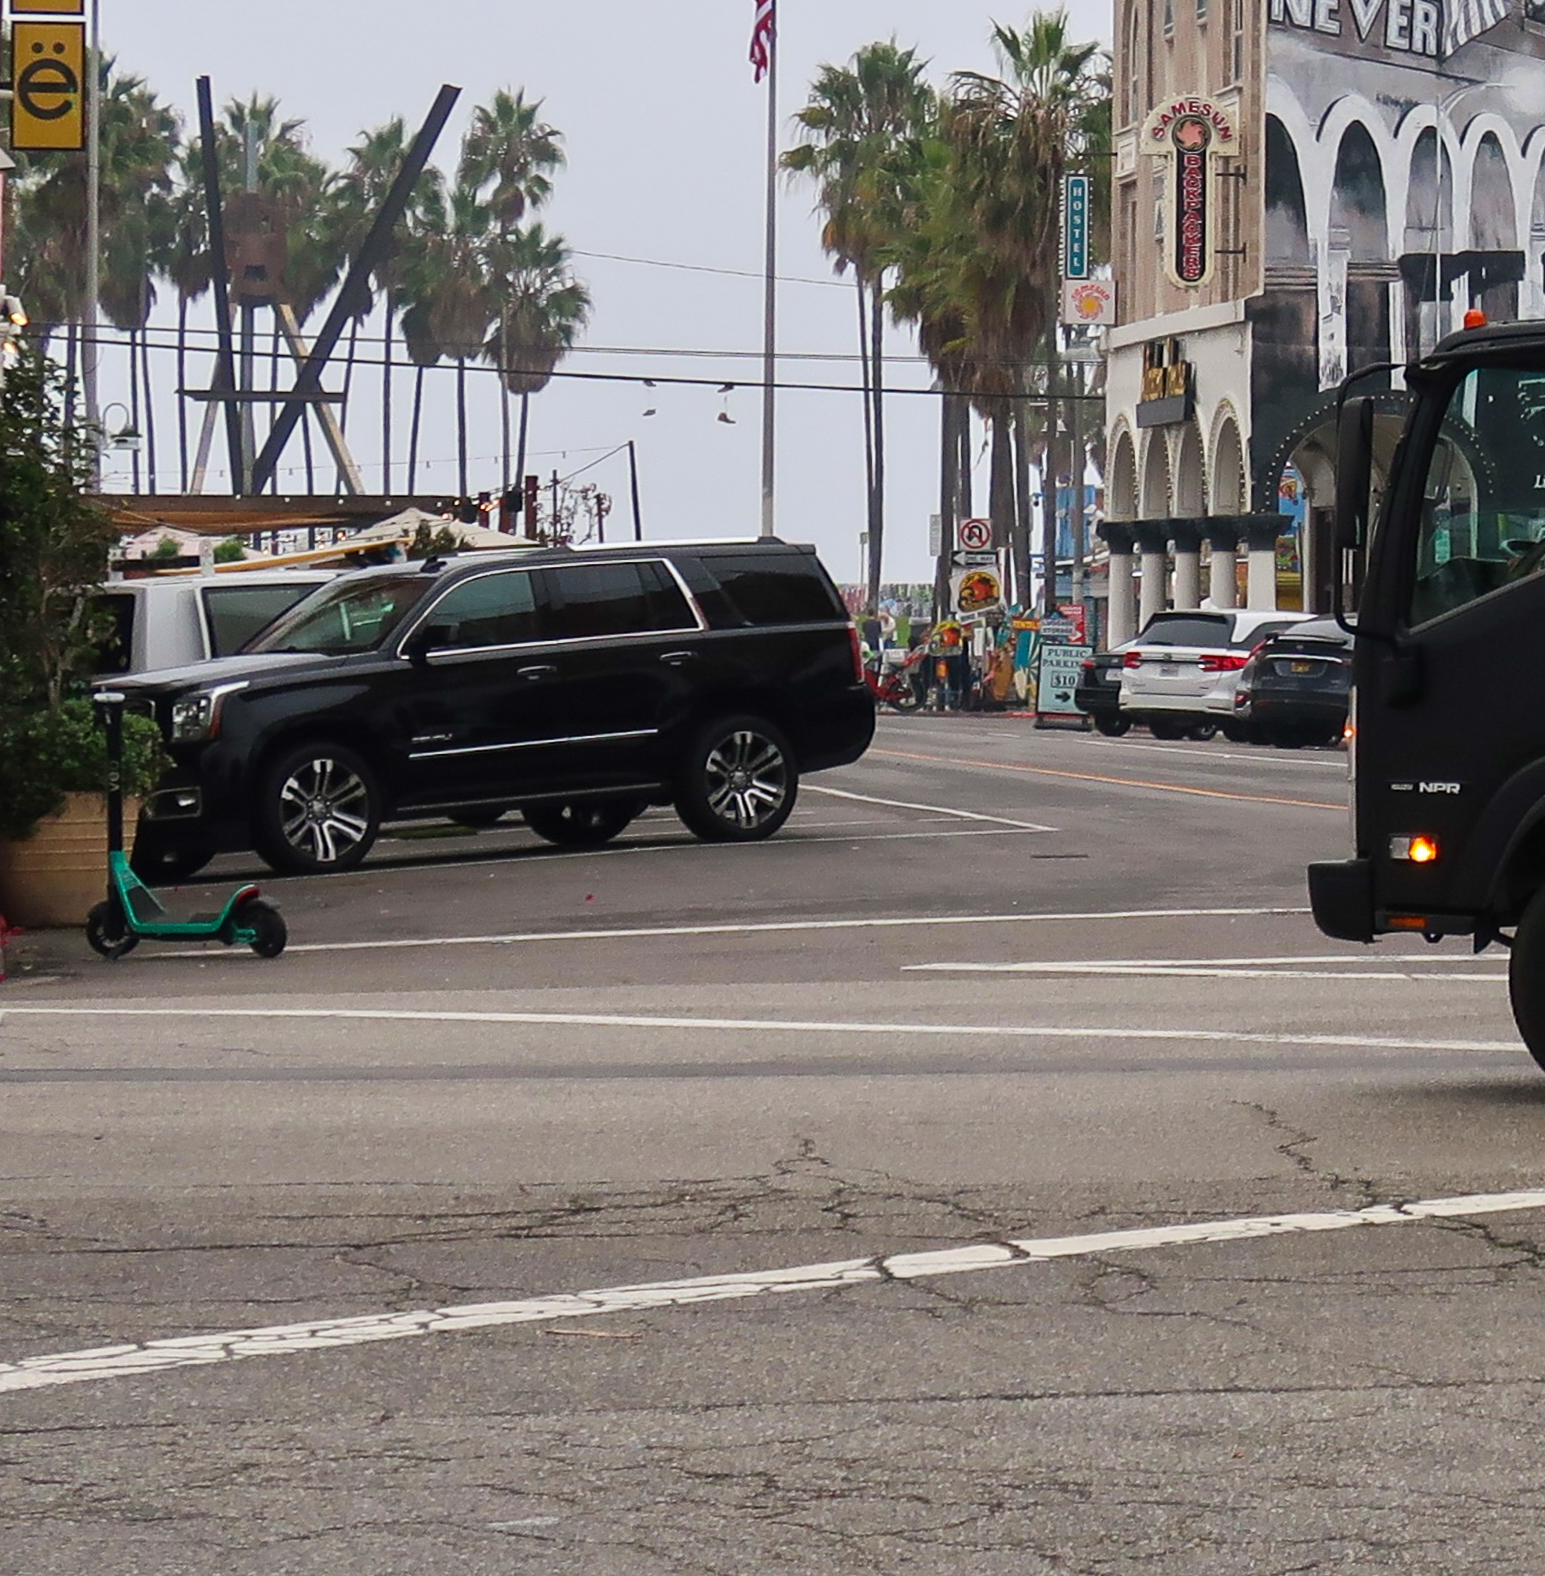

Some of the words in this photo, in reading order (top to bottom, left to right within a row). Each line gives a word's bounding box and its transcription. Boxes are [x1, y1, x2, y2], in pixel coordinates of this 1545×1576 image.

[1152, 100, 1233, 142] SAMESUN
[1182, 154, 1202, 280] BACKPACKERS
[1072, 186, 1082, 267] HOSTEL
[1047, 648, 1087, 658] PUBLIC
[1042, 659, 1082, 668] PARKIN
[1055, 675, 1076, 686] $10
[1419, 782, 1461, 794] NPR
